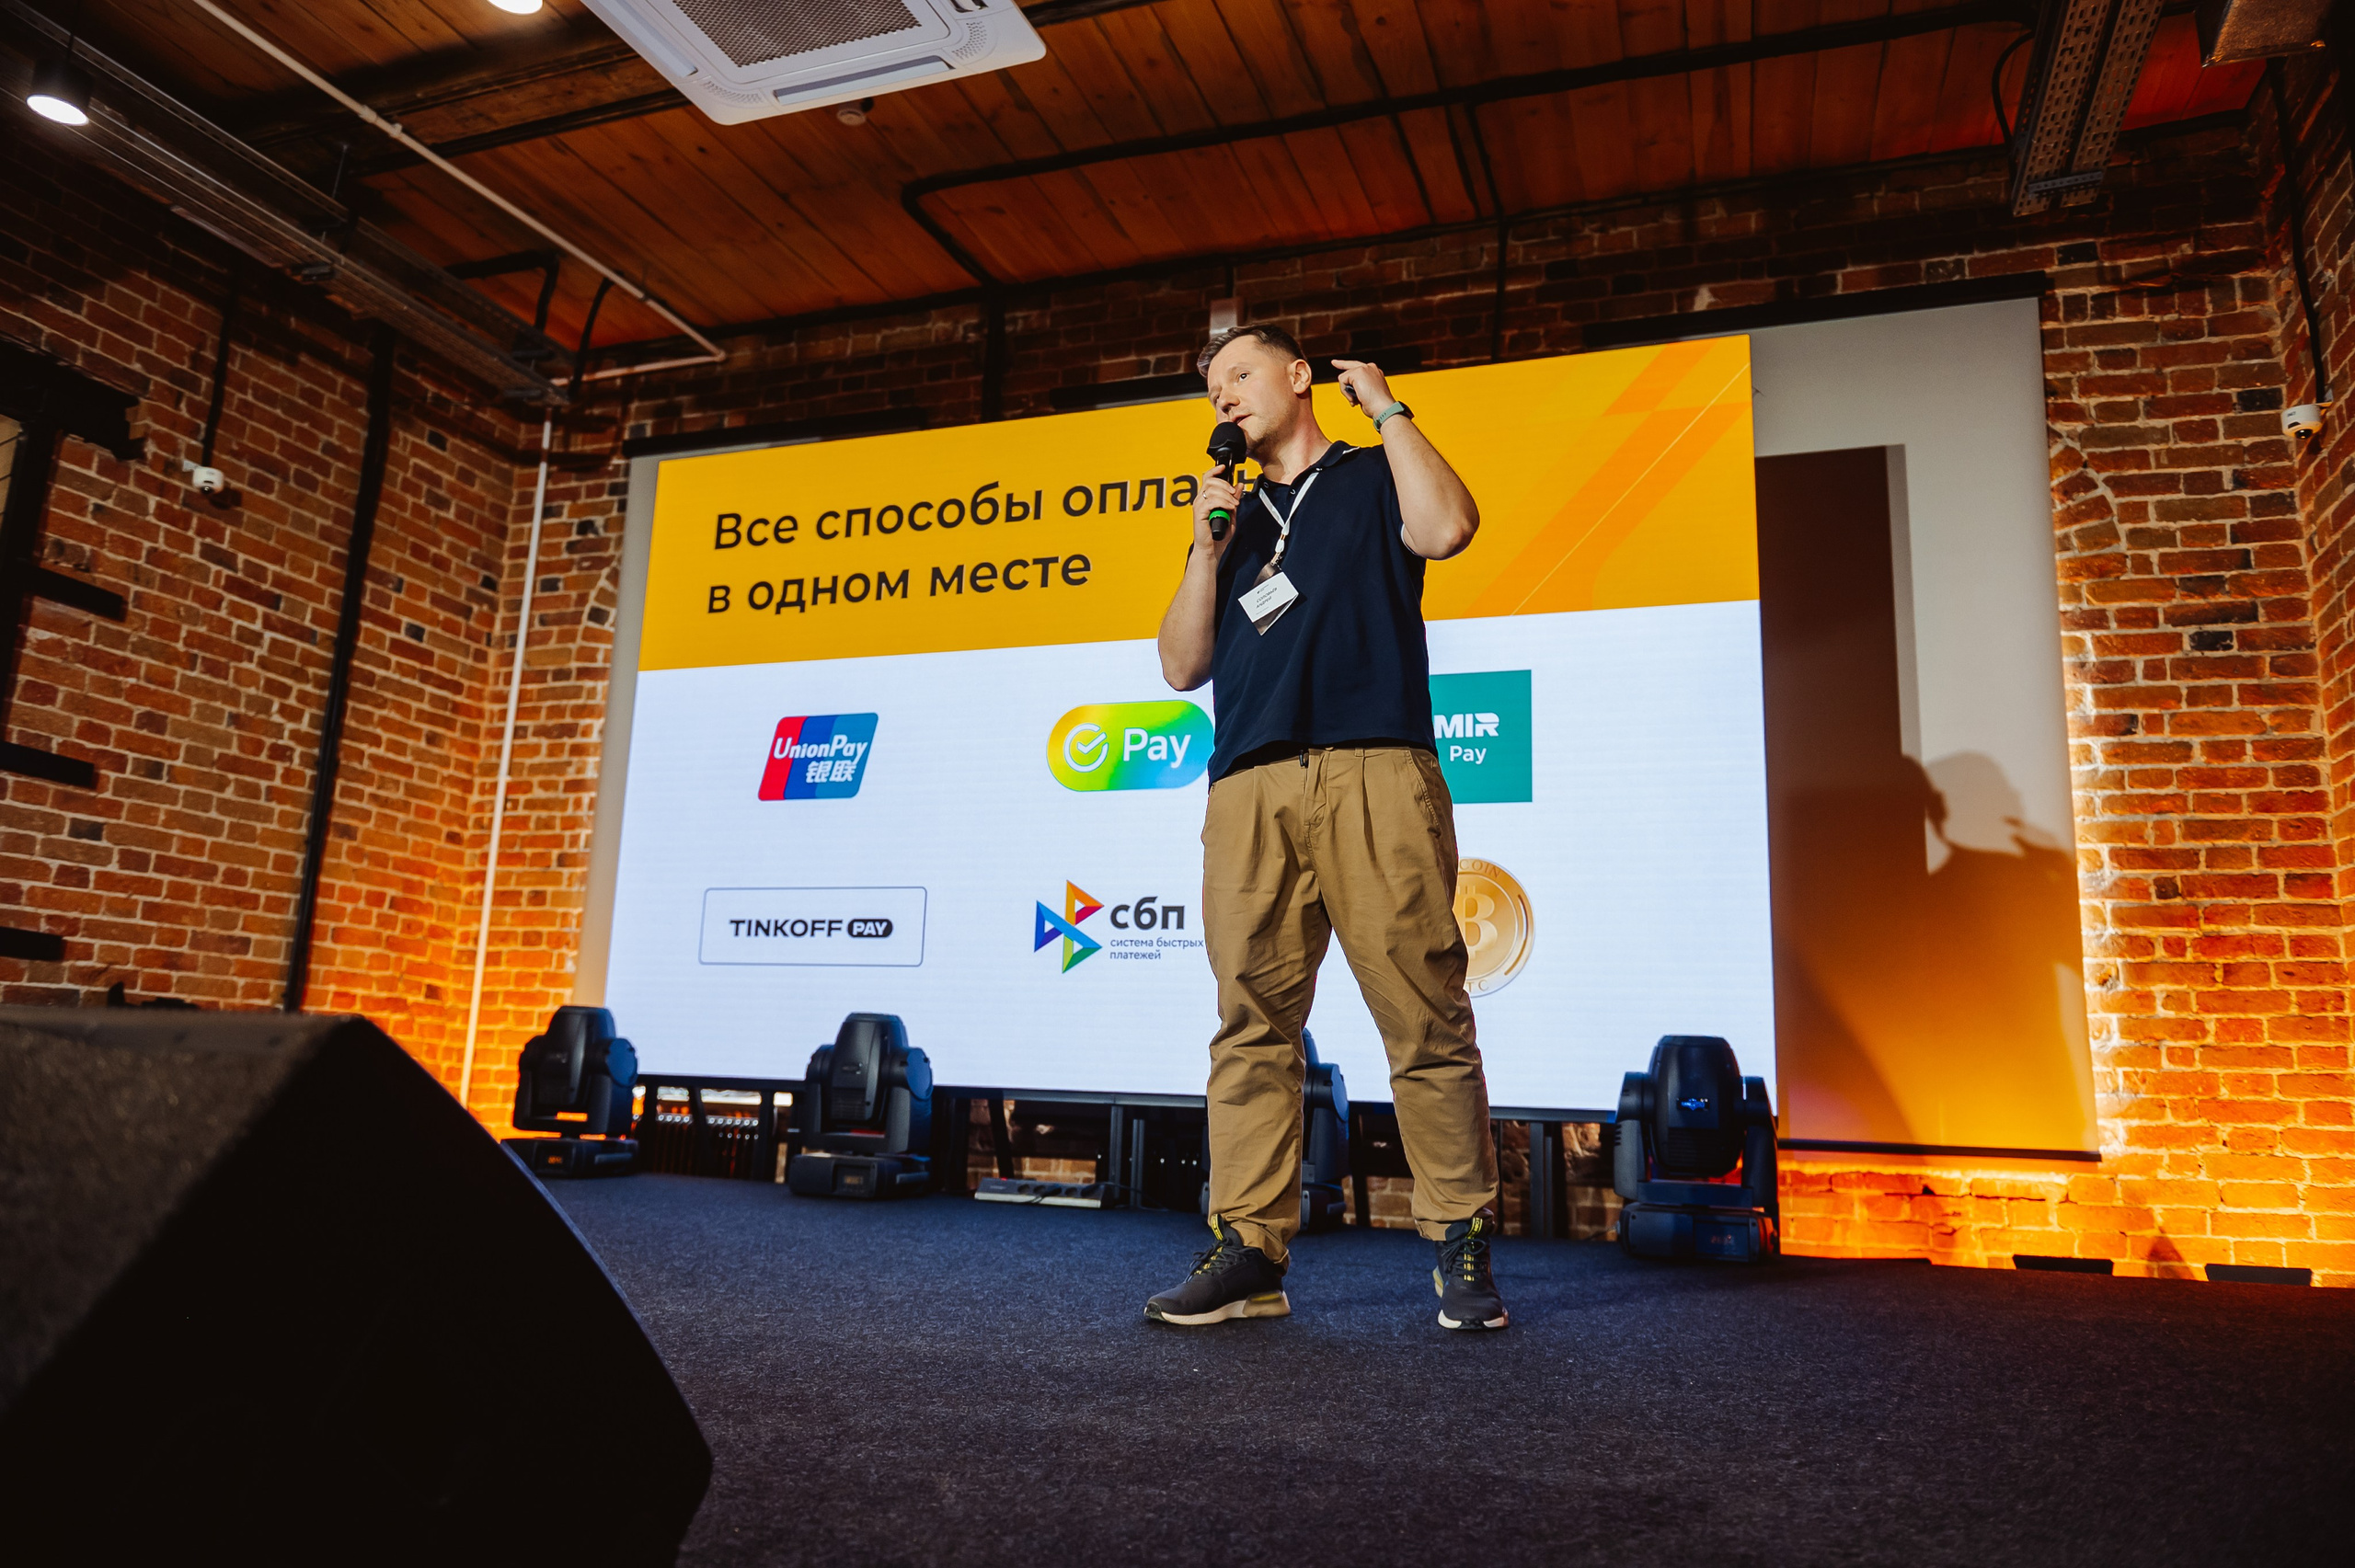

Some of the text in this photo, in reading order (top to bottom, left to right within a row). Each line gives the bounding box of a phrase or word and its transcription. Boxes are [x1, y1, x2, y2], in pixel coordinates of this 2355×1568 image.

[715, 469, 1257, 549] Все способы опла
[707, 554, 1092, 614] в одном месте
[1433, 712, 1499, 738] MIR
[774, 734, 867, 765] UnionPay
[1122, 727, 1191, 769] Pay
[1449, 745, 1487, 764] Pay
[806, 760, 856, 783] 银联
[1459, 858, 1501, 878] COIN
[729, 919, 889, 937] TINKOFF PAY
[1110, 936, 1204, 948] система быстрых
[1109, 950, 1161, 960] платежей
[1466, 979, 1489, 992] TC
